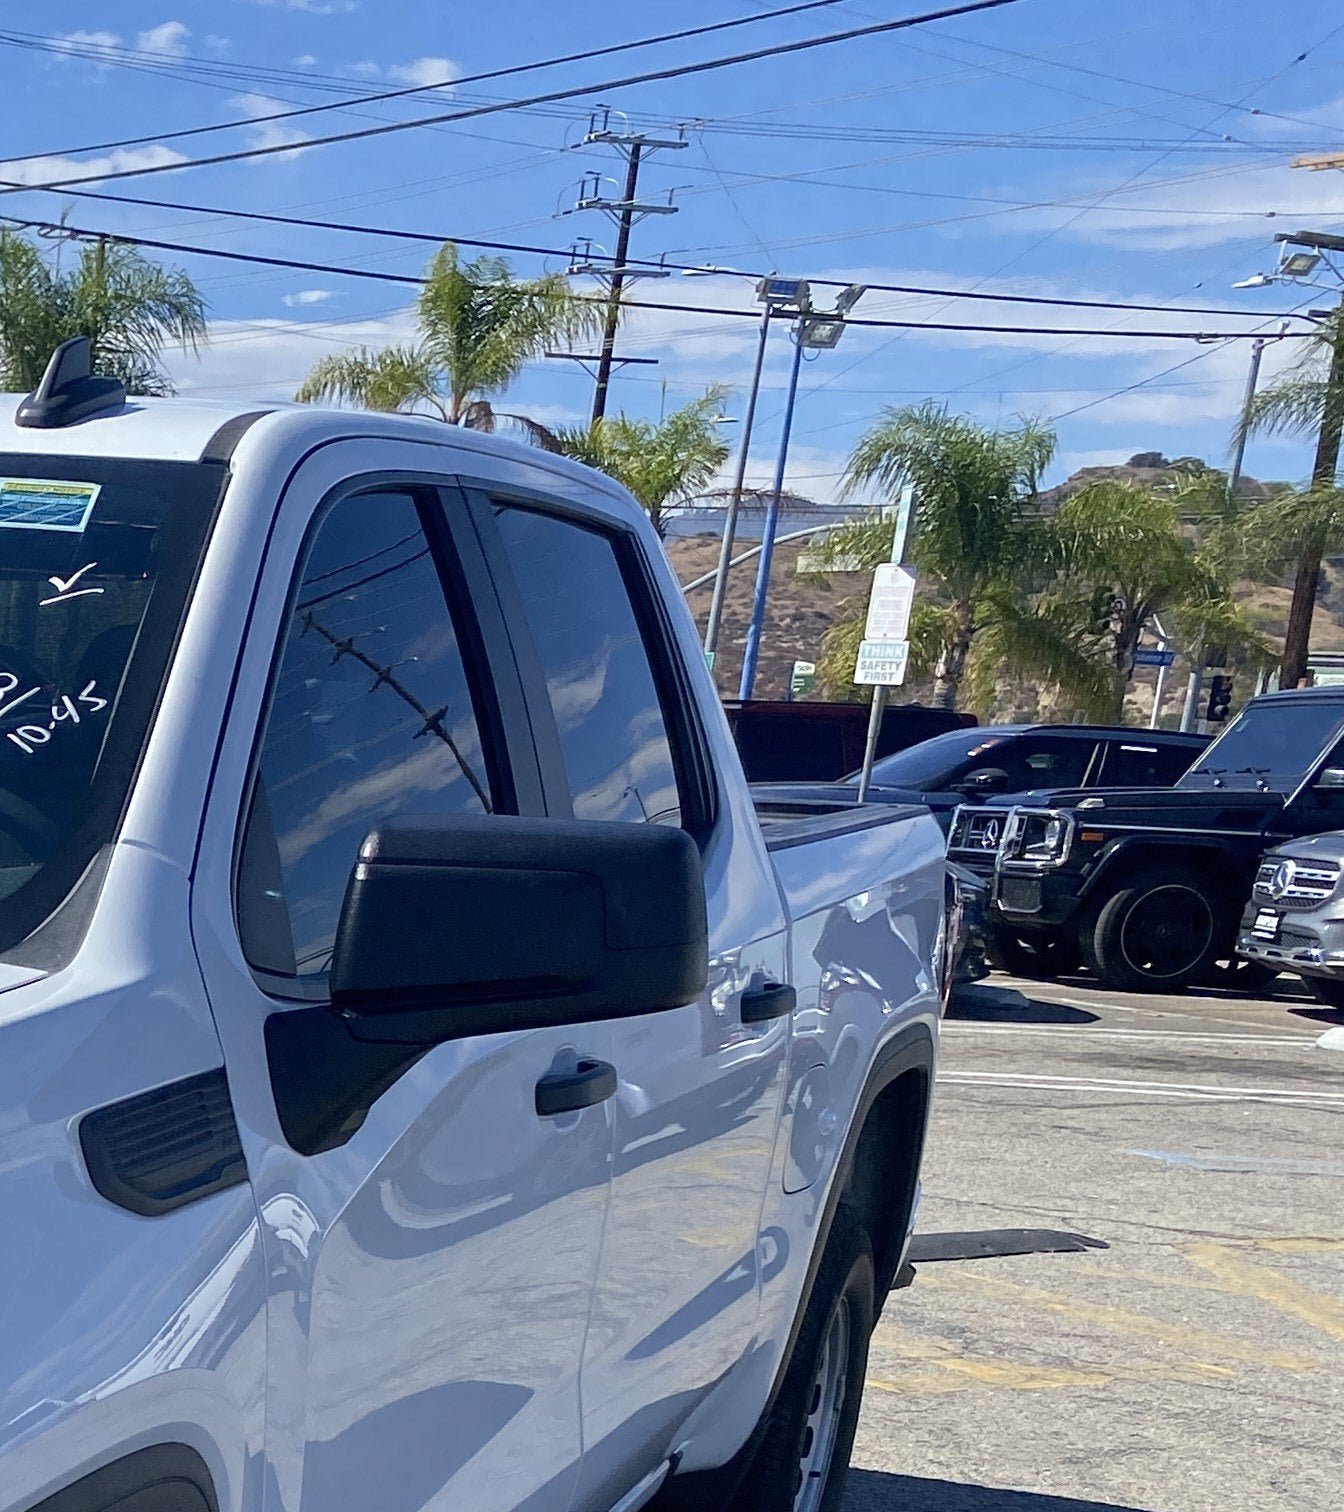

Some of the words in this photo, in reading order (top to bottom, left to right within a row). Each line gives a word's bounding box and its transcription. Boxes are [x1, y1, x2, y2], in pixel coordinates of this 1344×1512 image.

[863, 643, 905, 659] THINK
[860, 660, 902, 672] SAFETY
[863, 671, 896, 682] FIRST
